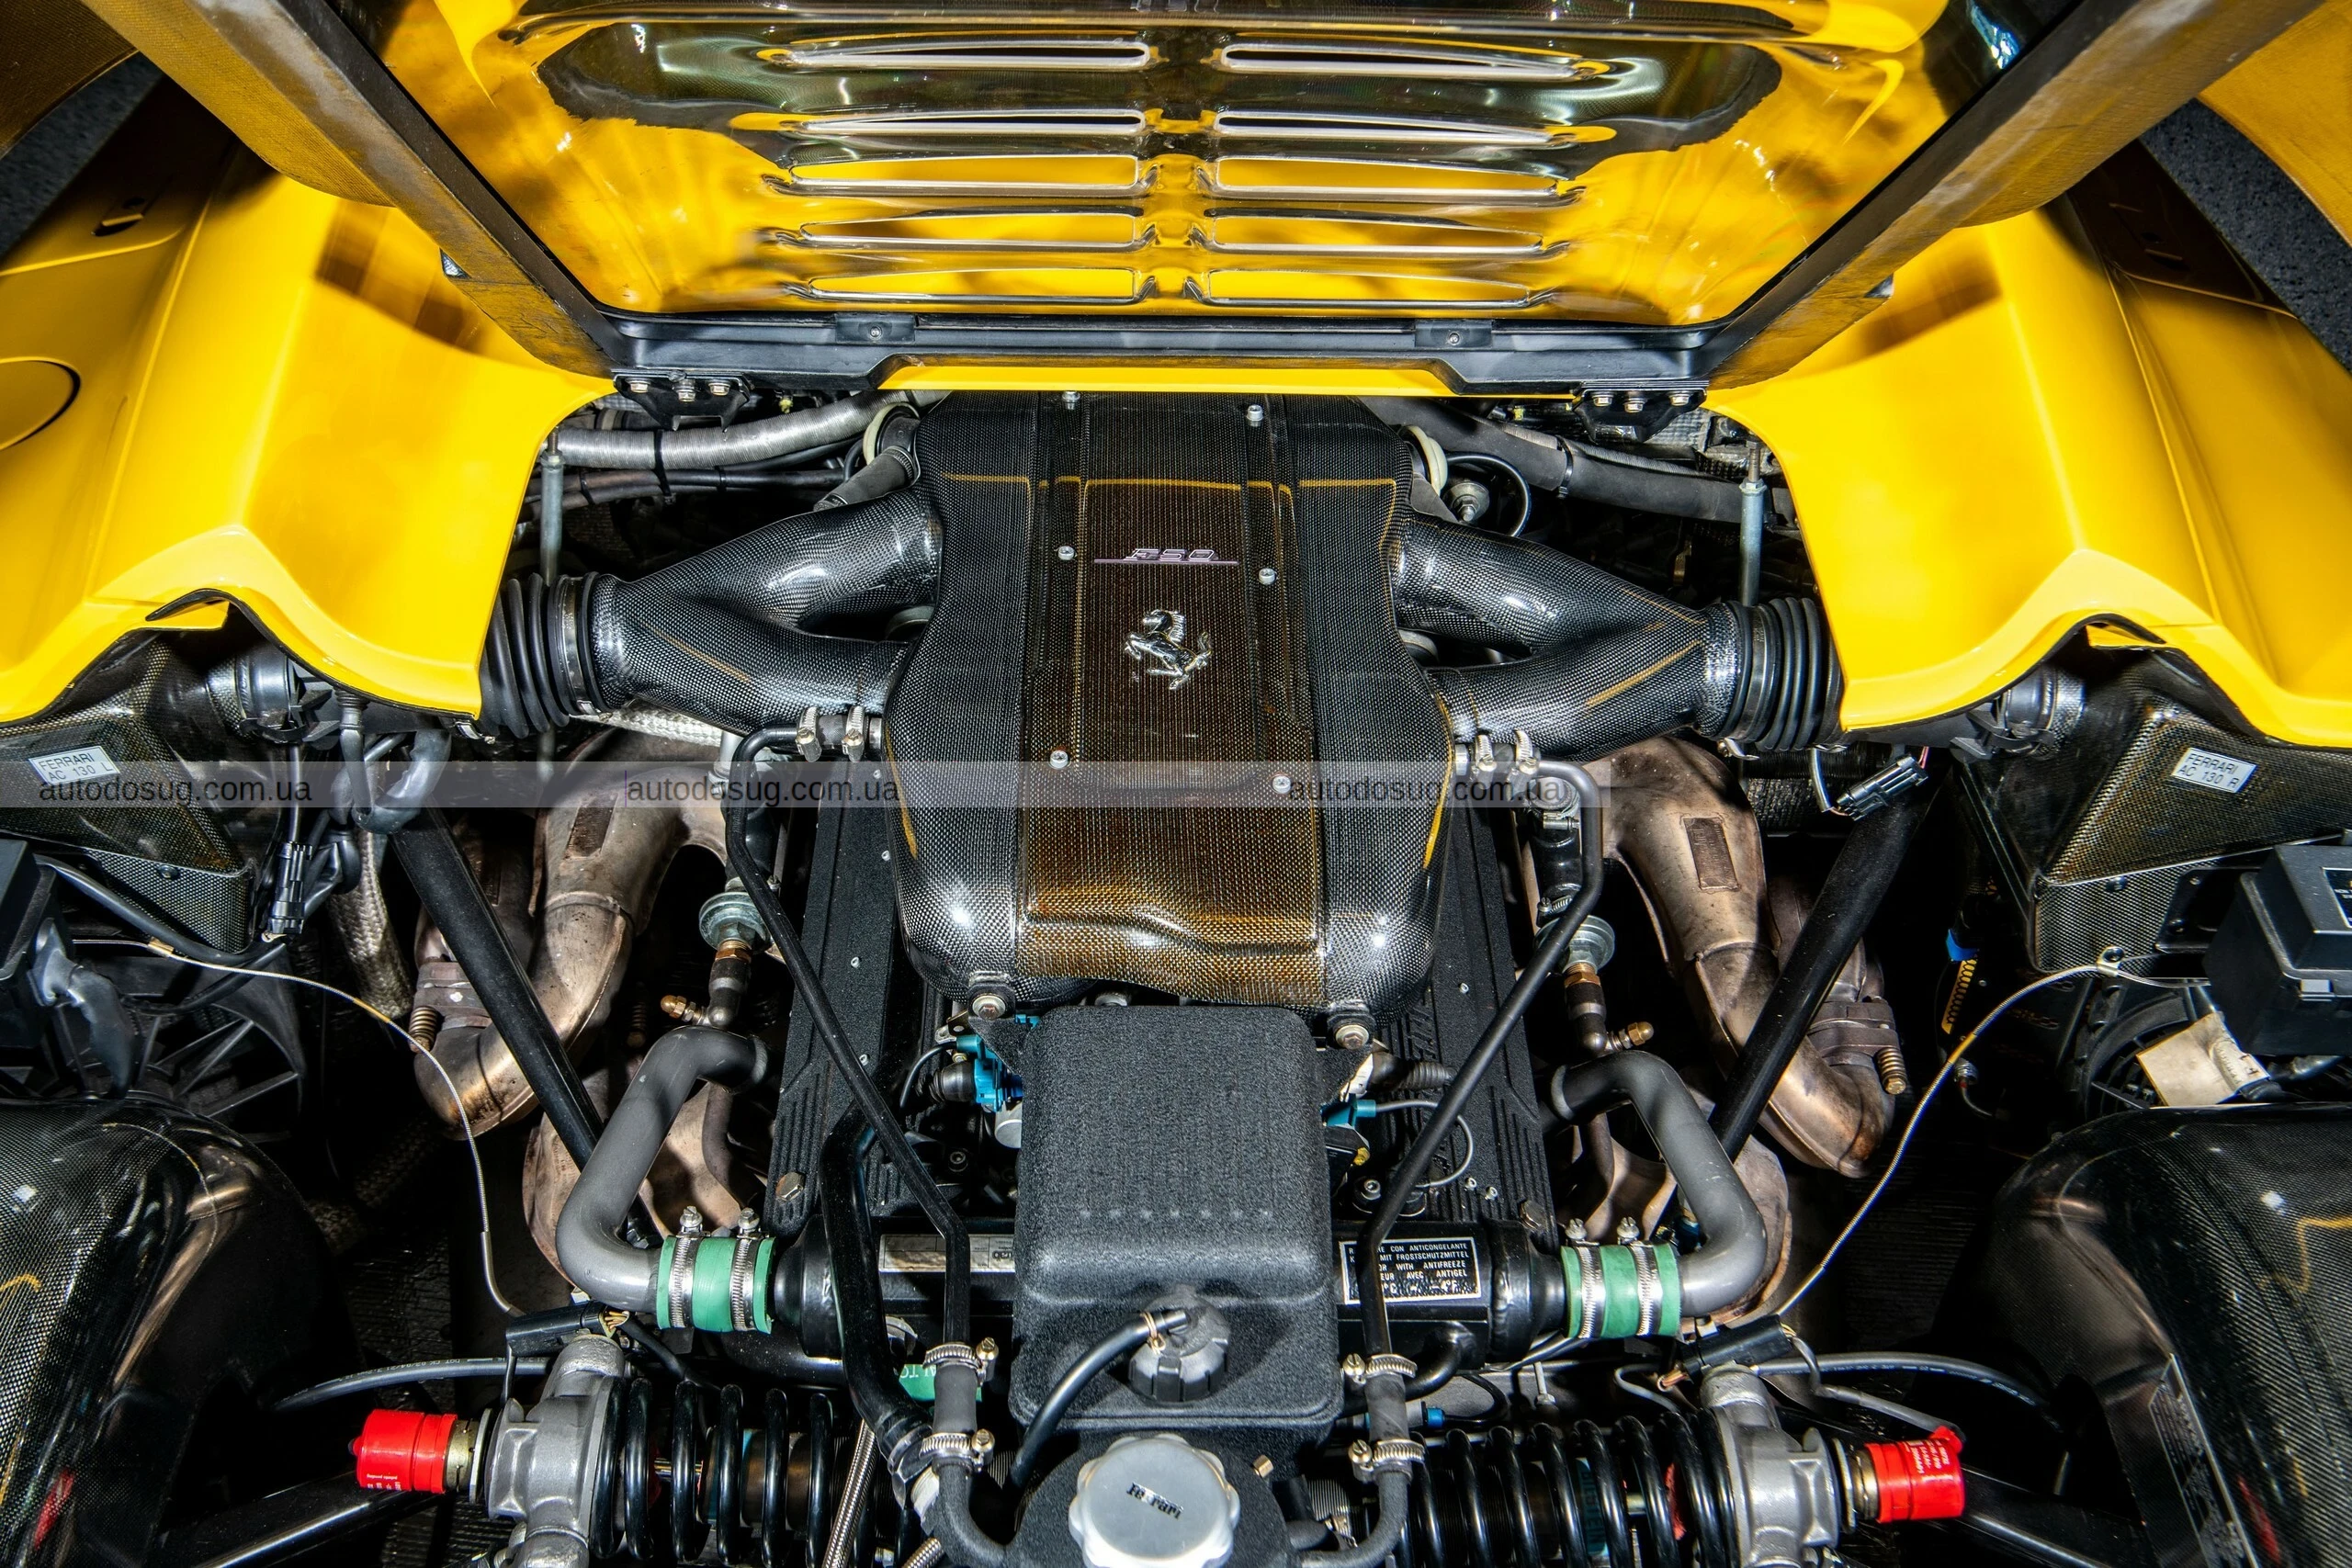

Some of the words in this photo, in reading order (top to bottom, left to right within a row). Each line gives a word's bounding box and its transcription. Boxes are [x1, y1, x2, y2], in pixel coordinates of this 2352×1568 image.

[38, 752, 95, 771] FERRARI
[2185, 752, 2240, 775] FERRARI
[48, 769, 67, 782] AC
[72, 764, 97, 778] 130
[100, 761, 114, 773] L
[2177, 765, 2195, 777] AC
[2201, 771, 2225, 784] 130
[2226, 777, 2241, 788] R
[1379, 1254, 1394, 1262] MIT
[1396, 1251, 1470, 1261] FROSTSCHUTZMITTEL
[1389, 1243, 1406, 1253] CON
[1408, 1243, 1468, 1253] ANTICONGELANTE
[1396, 1262, 1415, 1271] WITH
[1422, 1259, 1466, 1269] ANTIFREEZE
[1406, 1271, 1425, 1280] AVEC
[1435, 1269, 1469, 1279] ANTIGEL
[1125, 1482, 1184, 1520] Ferari
